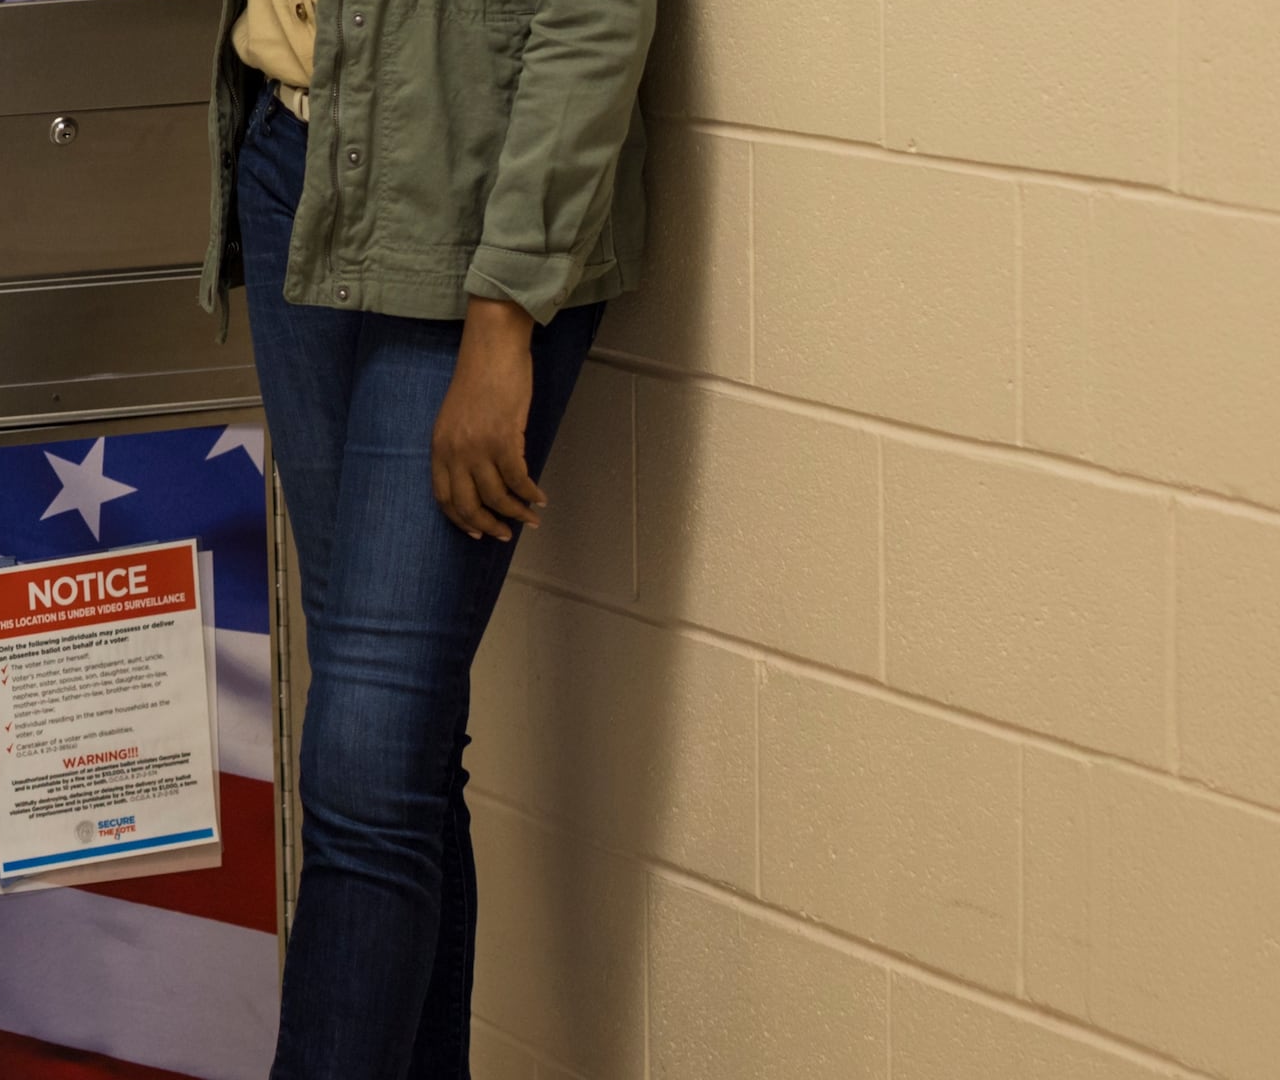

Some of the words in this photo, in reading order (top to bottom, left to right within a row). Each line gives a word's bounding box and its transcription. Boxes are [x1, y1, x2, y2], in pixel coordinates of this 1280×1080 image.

[27, 564, 148, 610] NOTICE
[15, 612, 56, 627] LOCATION
[58, 611, 65, 621] IS
[67, 606, 95, 619] UNDER
[97, 602, 123, 614] VIDEO
[124, 592, 185, 610] SURVEILLANCE
[15, 642, 26, 651] the
[28, 637, 60, 649] following
[61, 631, 97, 644] individuals
[99, 629, 112, 638] may
[115, 625, 140, 636] possess
[142, 623, 149, 631] or
[151, 619, 174, 630] deliver
[9, 649, 39, 660] absentee
[41, 646, 60, 655] ballot
[62, 644, 70, 652] on
[72, 641, 93, 650] behalf
[109, 635, 129, 644] voter:
[11, 663, 22, 671] The
[24, 660, 41, 669] voter
[43, 658, 55, 666] him
[57, 656, 64, 664] or
[48, 714, 74, 724] residing
[75, 712, 82, 720] in
[83, 710, 94, 719] the
[96, 707, 112, 717] same
[114, 702, 148, 714] household
[150, 700, 157, 708] as
[159, 698, 170, 707] the
[16, 739, 48, 751] Caretaker
[64, 734, 80, 743] voter
[83, 732, 97, 740] with
[63, 746, 139, 768] WARNING!!!
[97, 815, 135, 829] SECURE
[98, 828, 113, 837] THE
